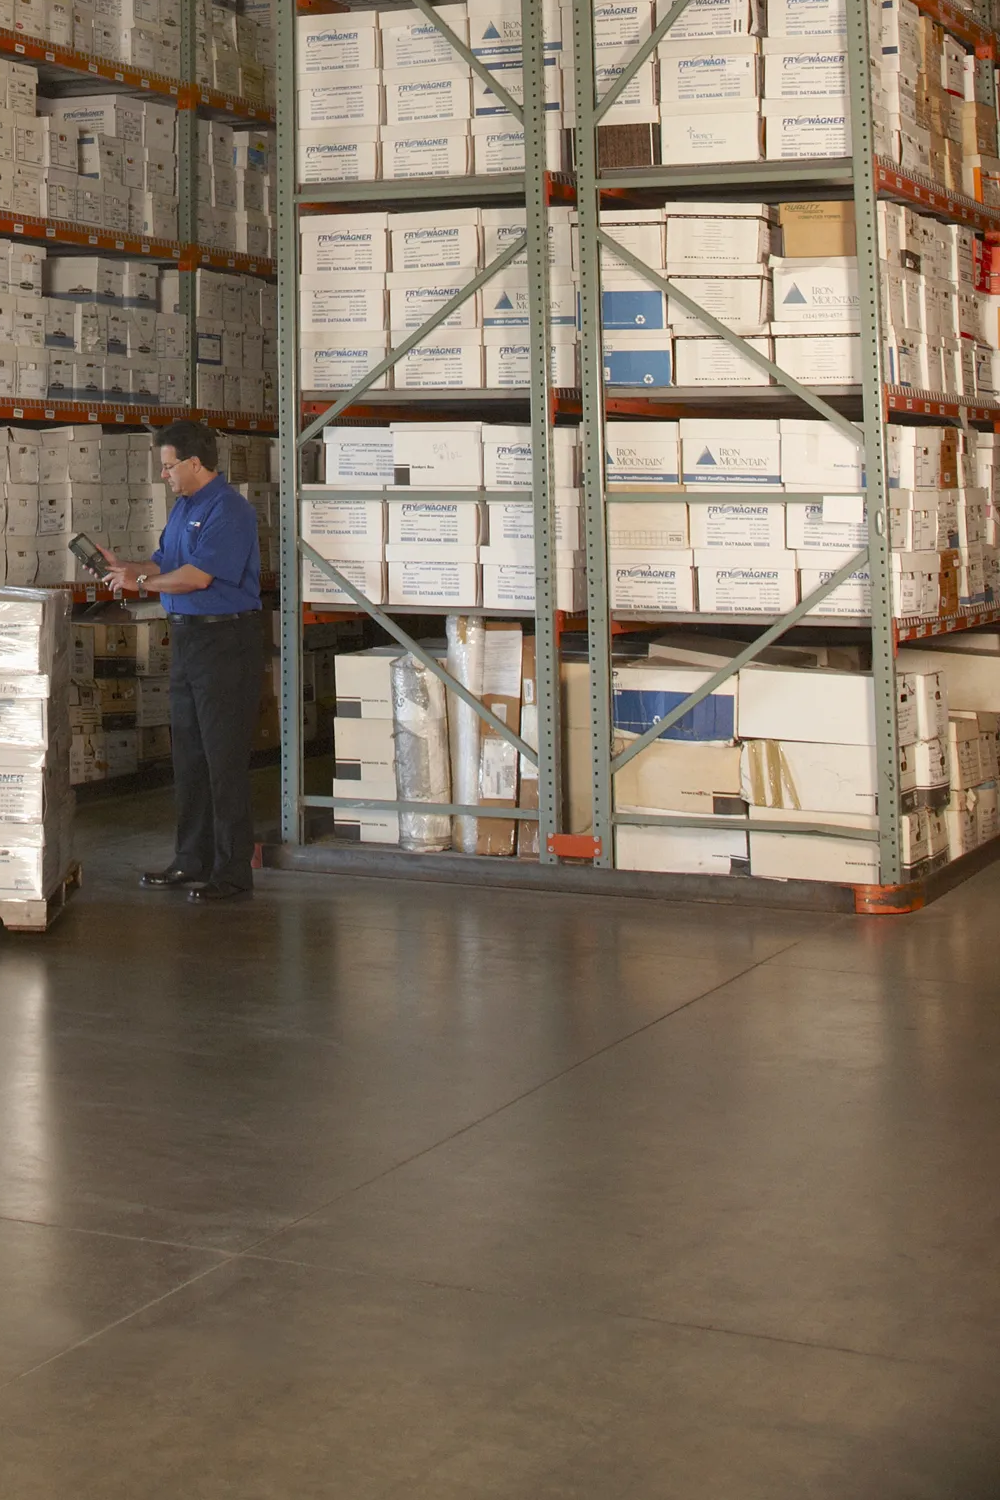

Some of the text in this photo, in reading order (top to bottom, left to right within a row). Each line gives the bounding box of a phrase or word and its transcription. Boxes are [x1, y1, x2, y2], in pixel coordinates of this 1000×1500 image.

[812, 287, 834, 295] IRON
[812, 295, 860, 305] MOUNTAIN
[616, 447, 636, 456] IRON
[719, 447, 740, 456] IRON
[616, 456, 662, 465] MOUNTAIN
[719, 456, 767, 465] MOUNTAIN
[424, 503, 457, 512] WAGNER
[707, 505, 768, 514] FRY WAGNER
[616, 569, 676, 578] FRY WAGNER
[716, 569, 779, 579] FRY WAGNER
